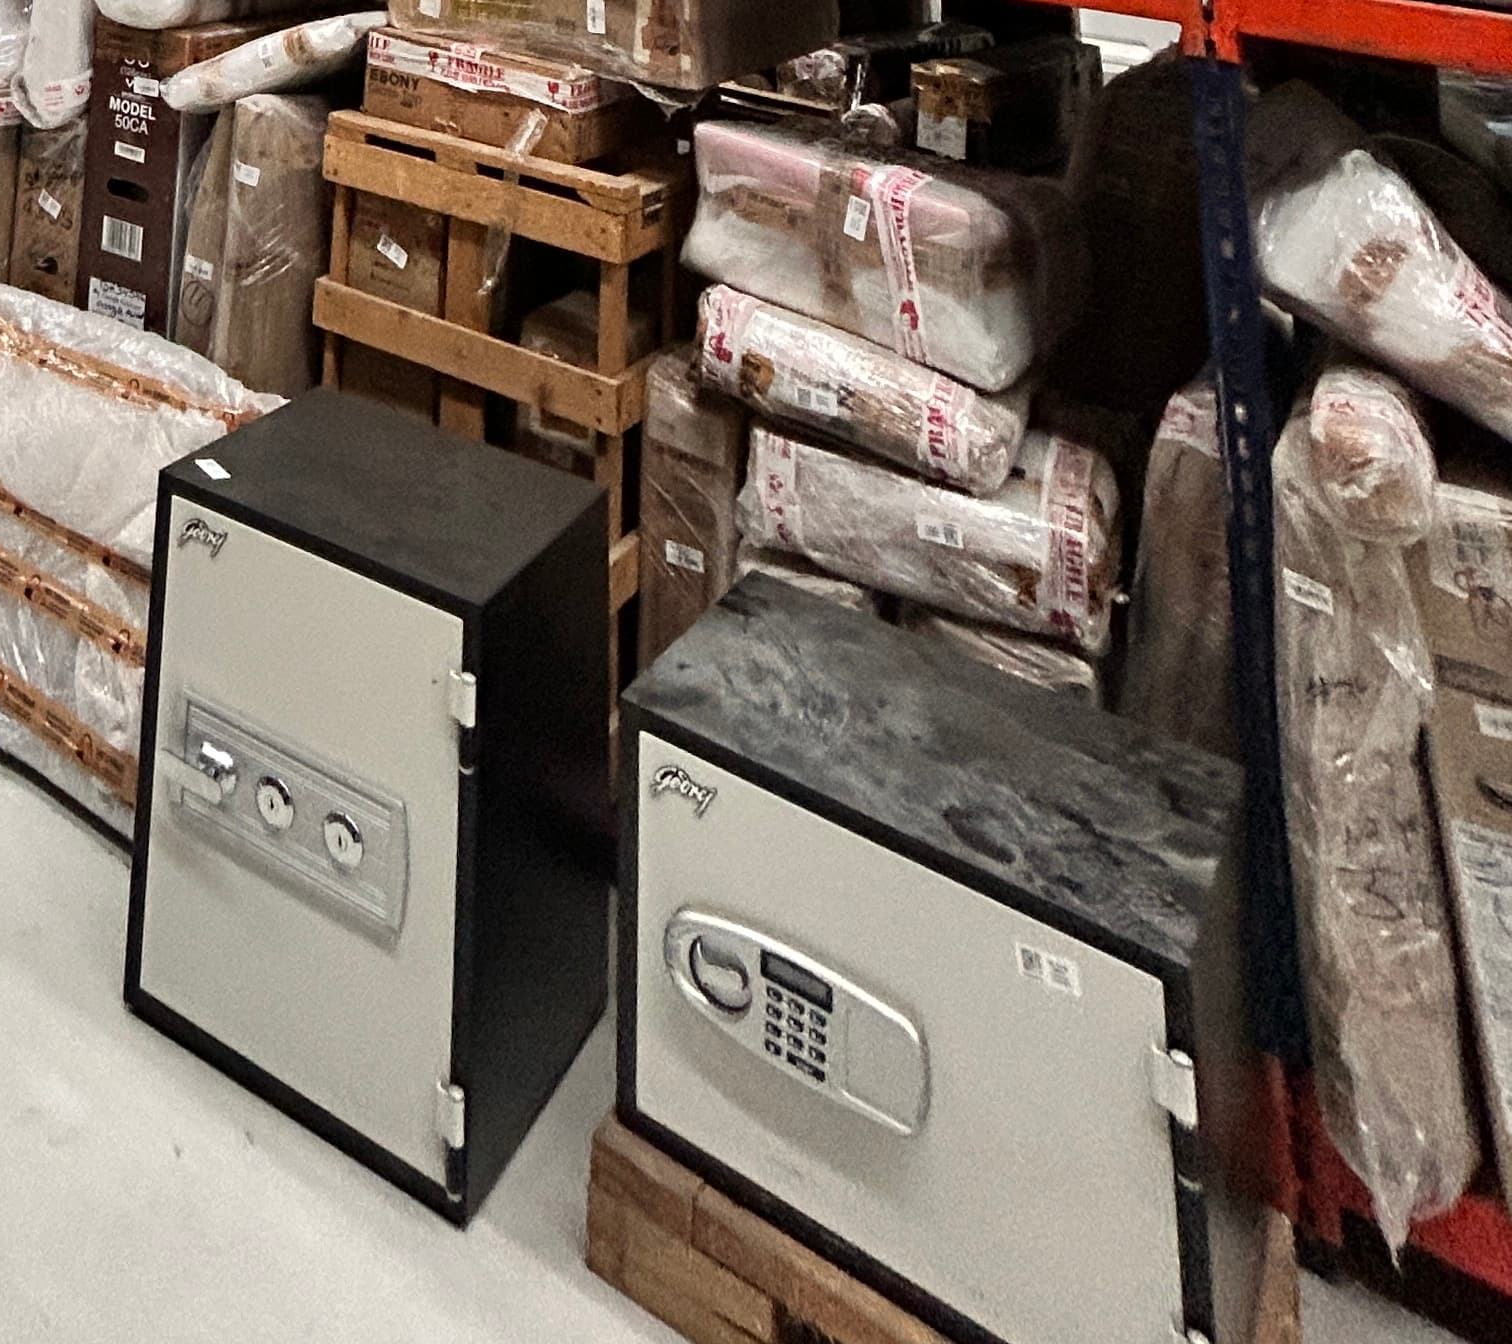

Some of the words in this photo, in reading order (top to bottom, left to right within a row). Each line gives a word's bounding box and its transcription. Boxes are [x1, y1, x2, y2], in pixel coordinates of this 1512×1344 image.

[369, 68, 421, 92] EBONY
[109, 95, 156, 120] MODEL
[114, 113, 149, 136] 50CA
